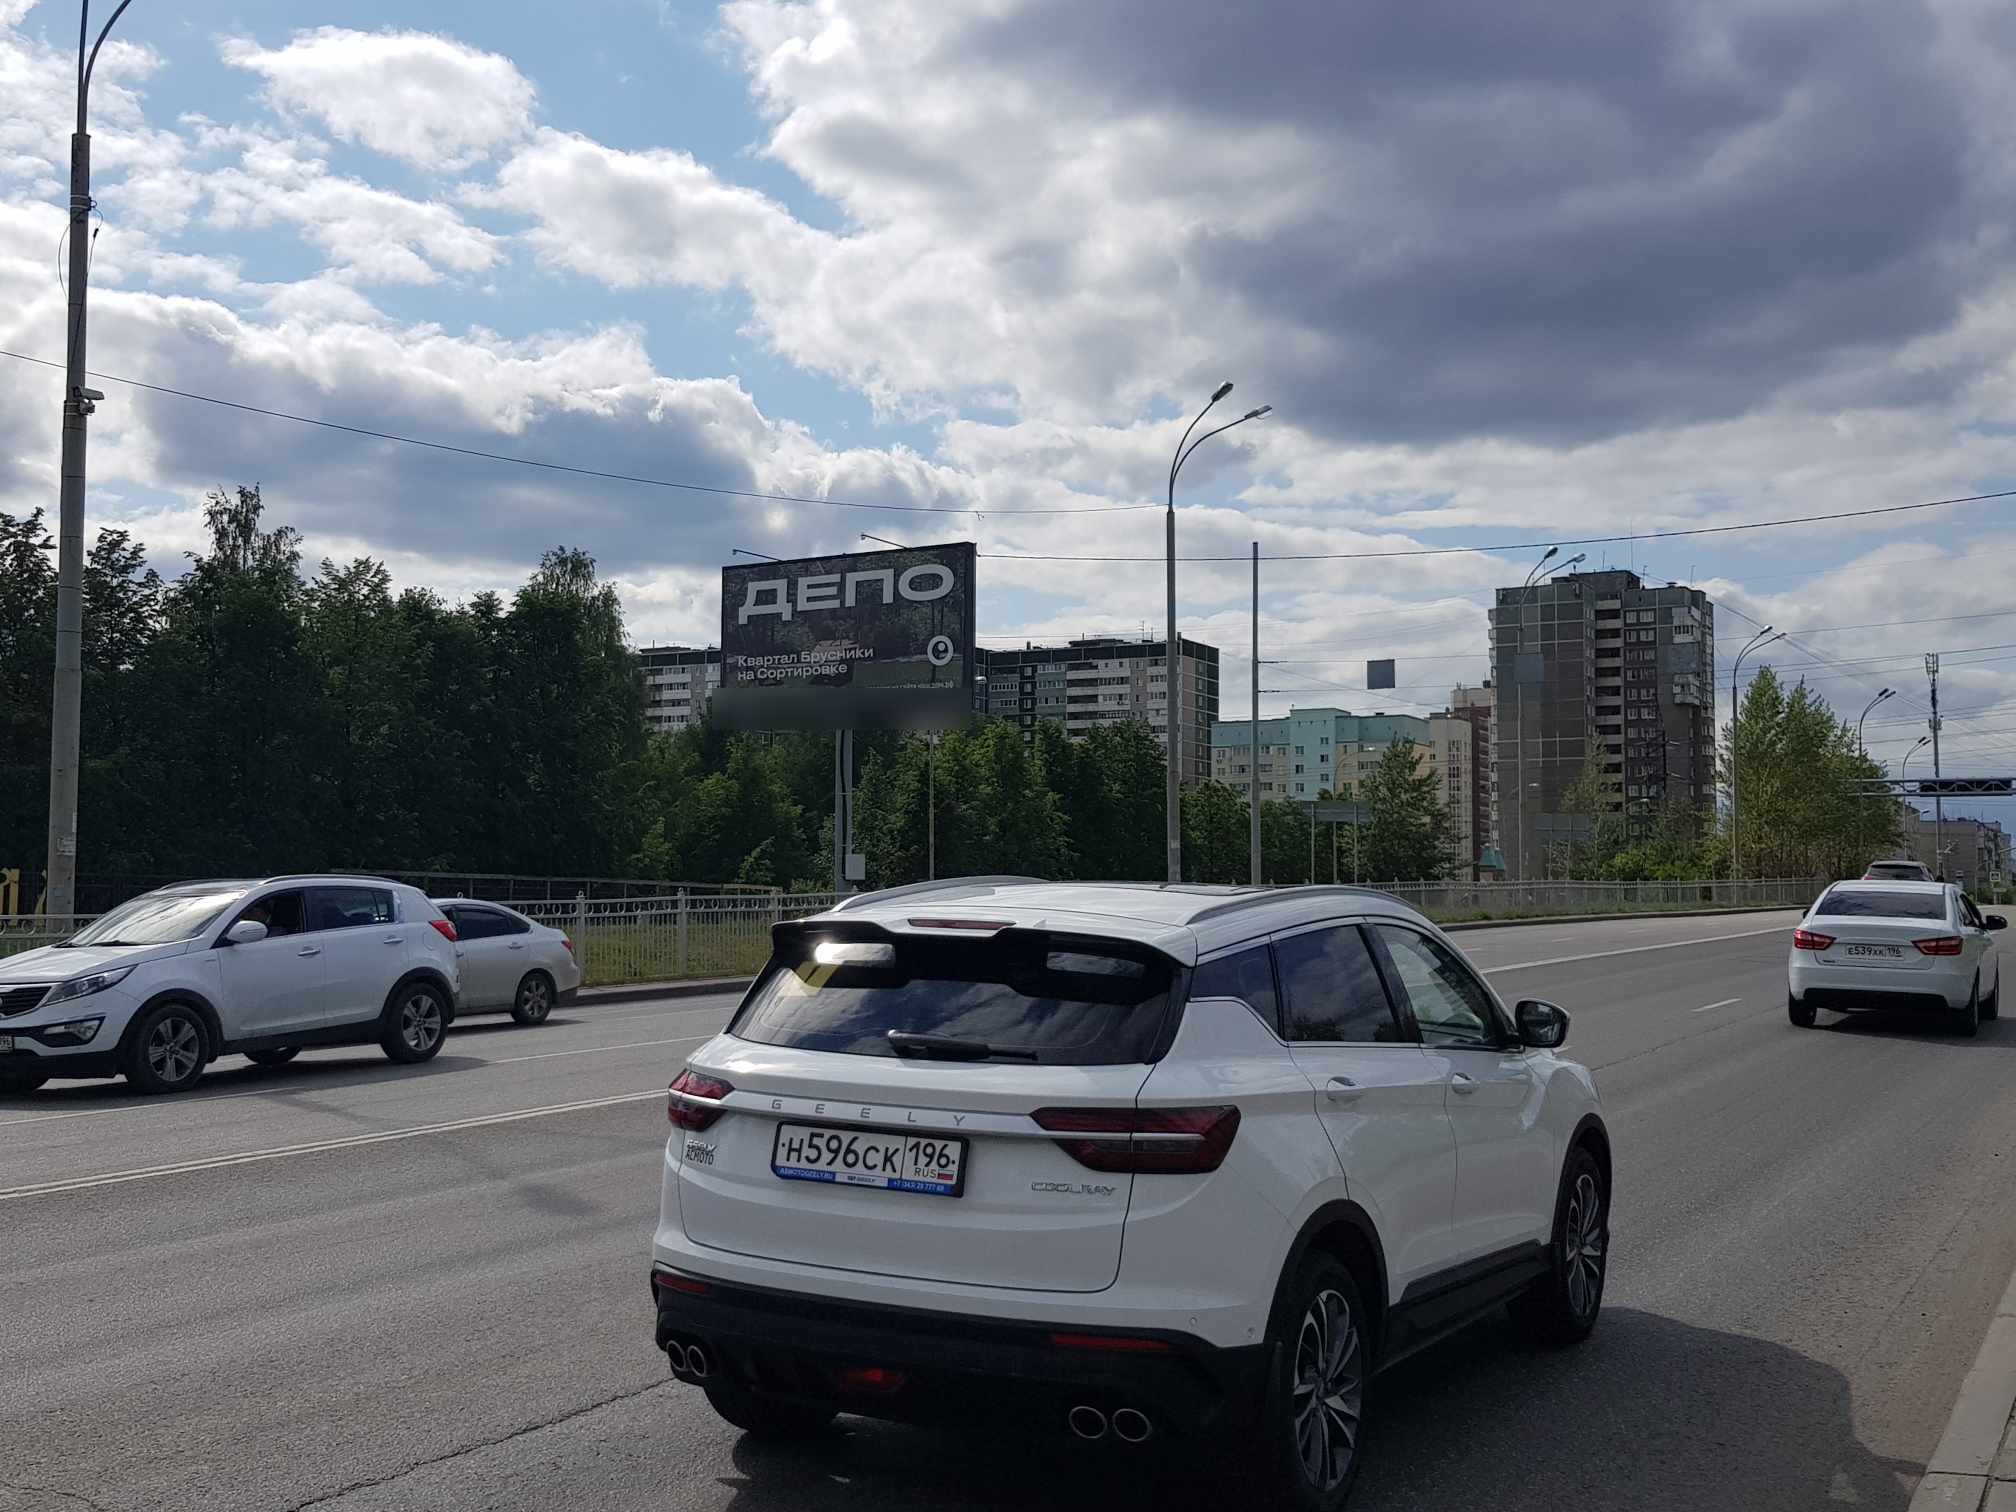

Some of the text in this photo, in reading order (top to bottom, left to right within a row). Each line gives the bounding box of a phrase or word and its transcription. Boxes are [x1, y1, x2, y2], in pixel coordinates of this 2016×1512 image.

[738, 564, 954, 624] ДЕПО
[737, 648, 874, 667] Квартал Брусники
[738, 664, 848, 681] на Сортировке
[771, 1099, 966, 1126] GEELY
[909, 1141, 949, 1168] 196
[914, 1167, 937, 1179] RUS
